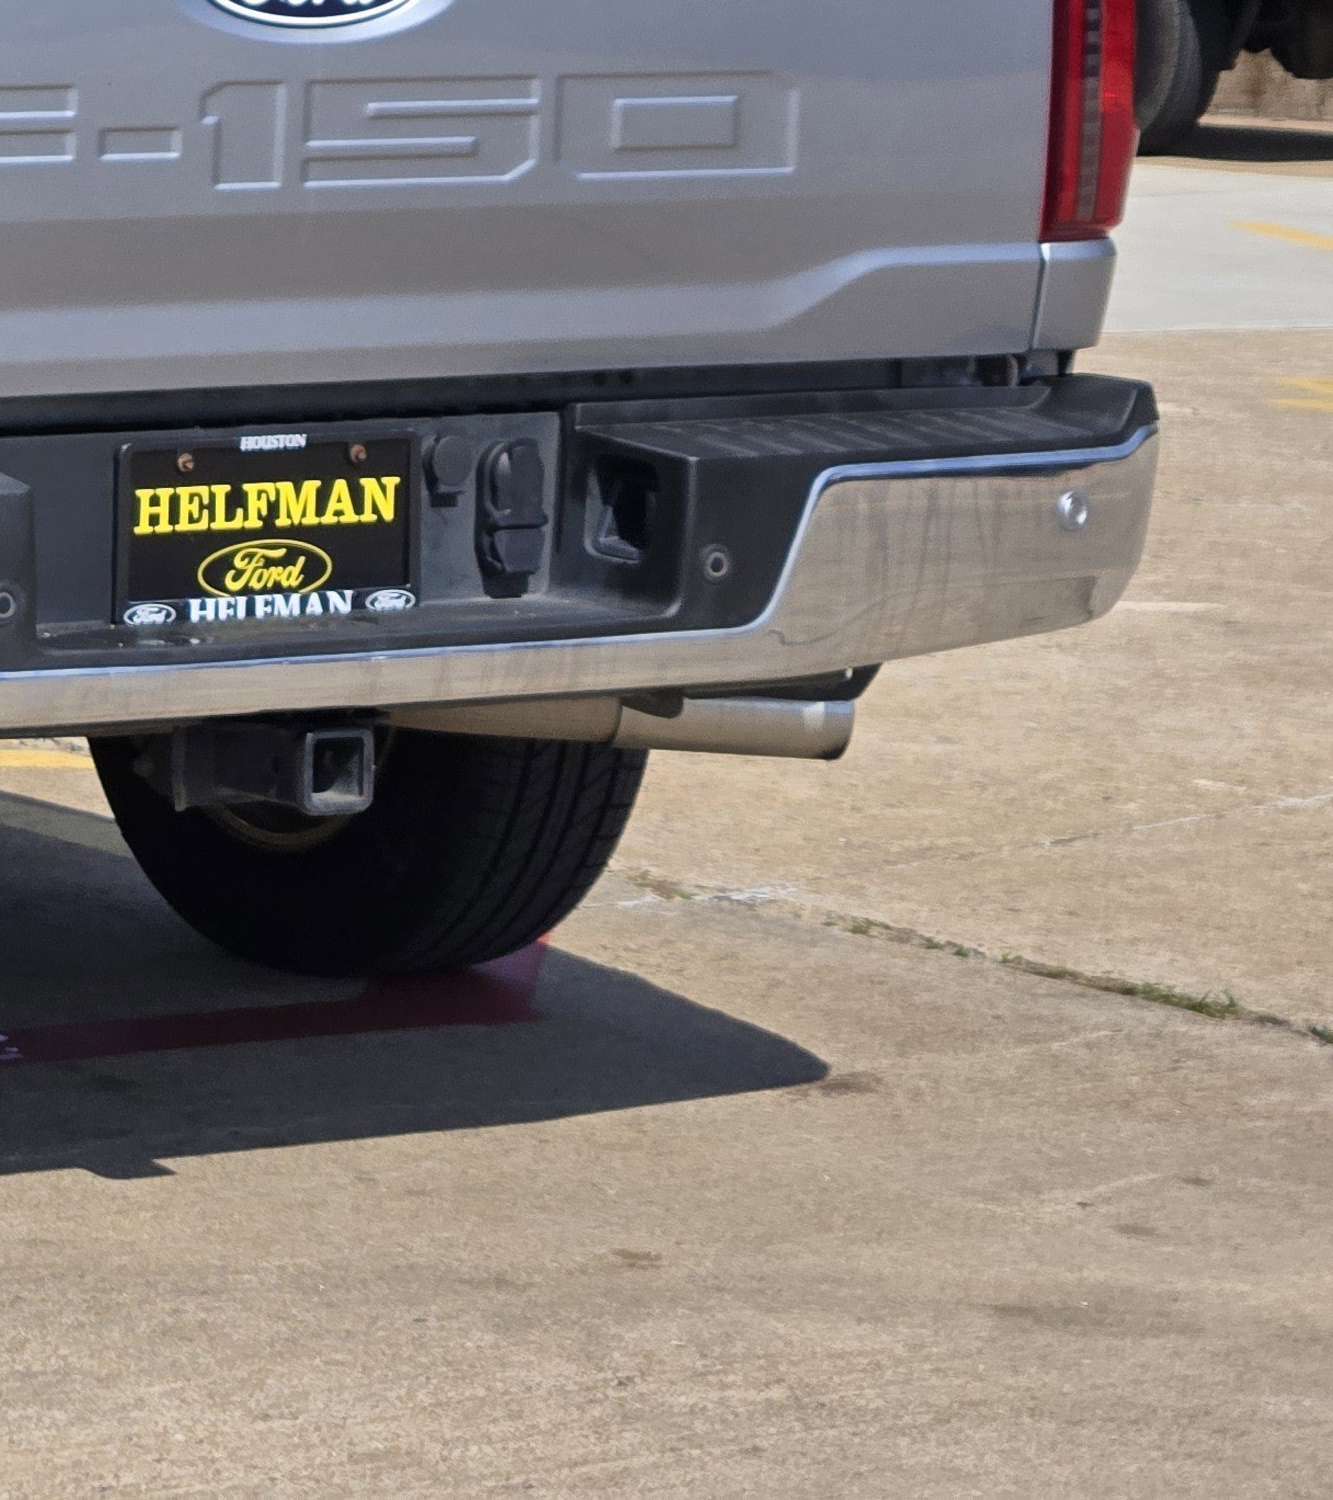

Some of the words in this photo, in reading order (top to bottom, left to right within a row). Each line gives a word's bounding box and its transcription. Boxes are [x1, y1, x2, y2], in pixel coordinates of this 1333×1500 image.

[239, 433, 308, 452] HOUSTON
[133, 476, 401, 535] HELFMAN
[224, 546, 307, 592] Ford
[189, 589, 354, 623] HELFMAN
